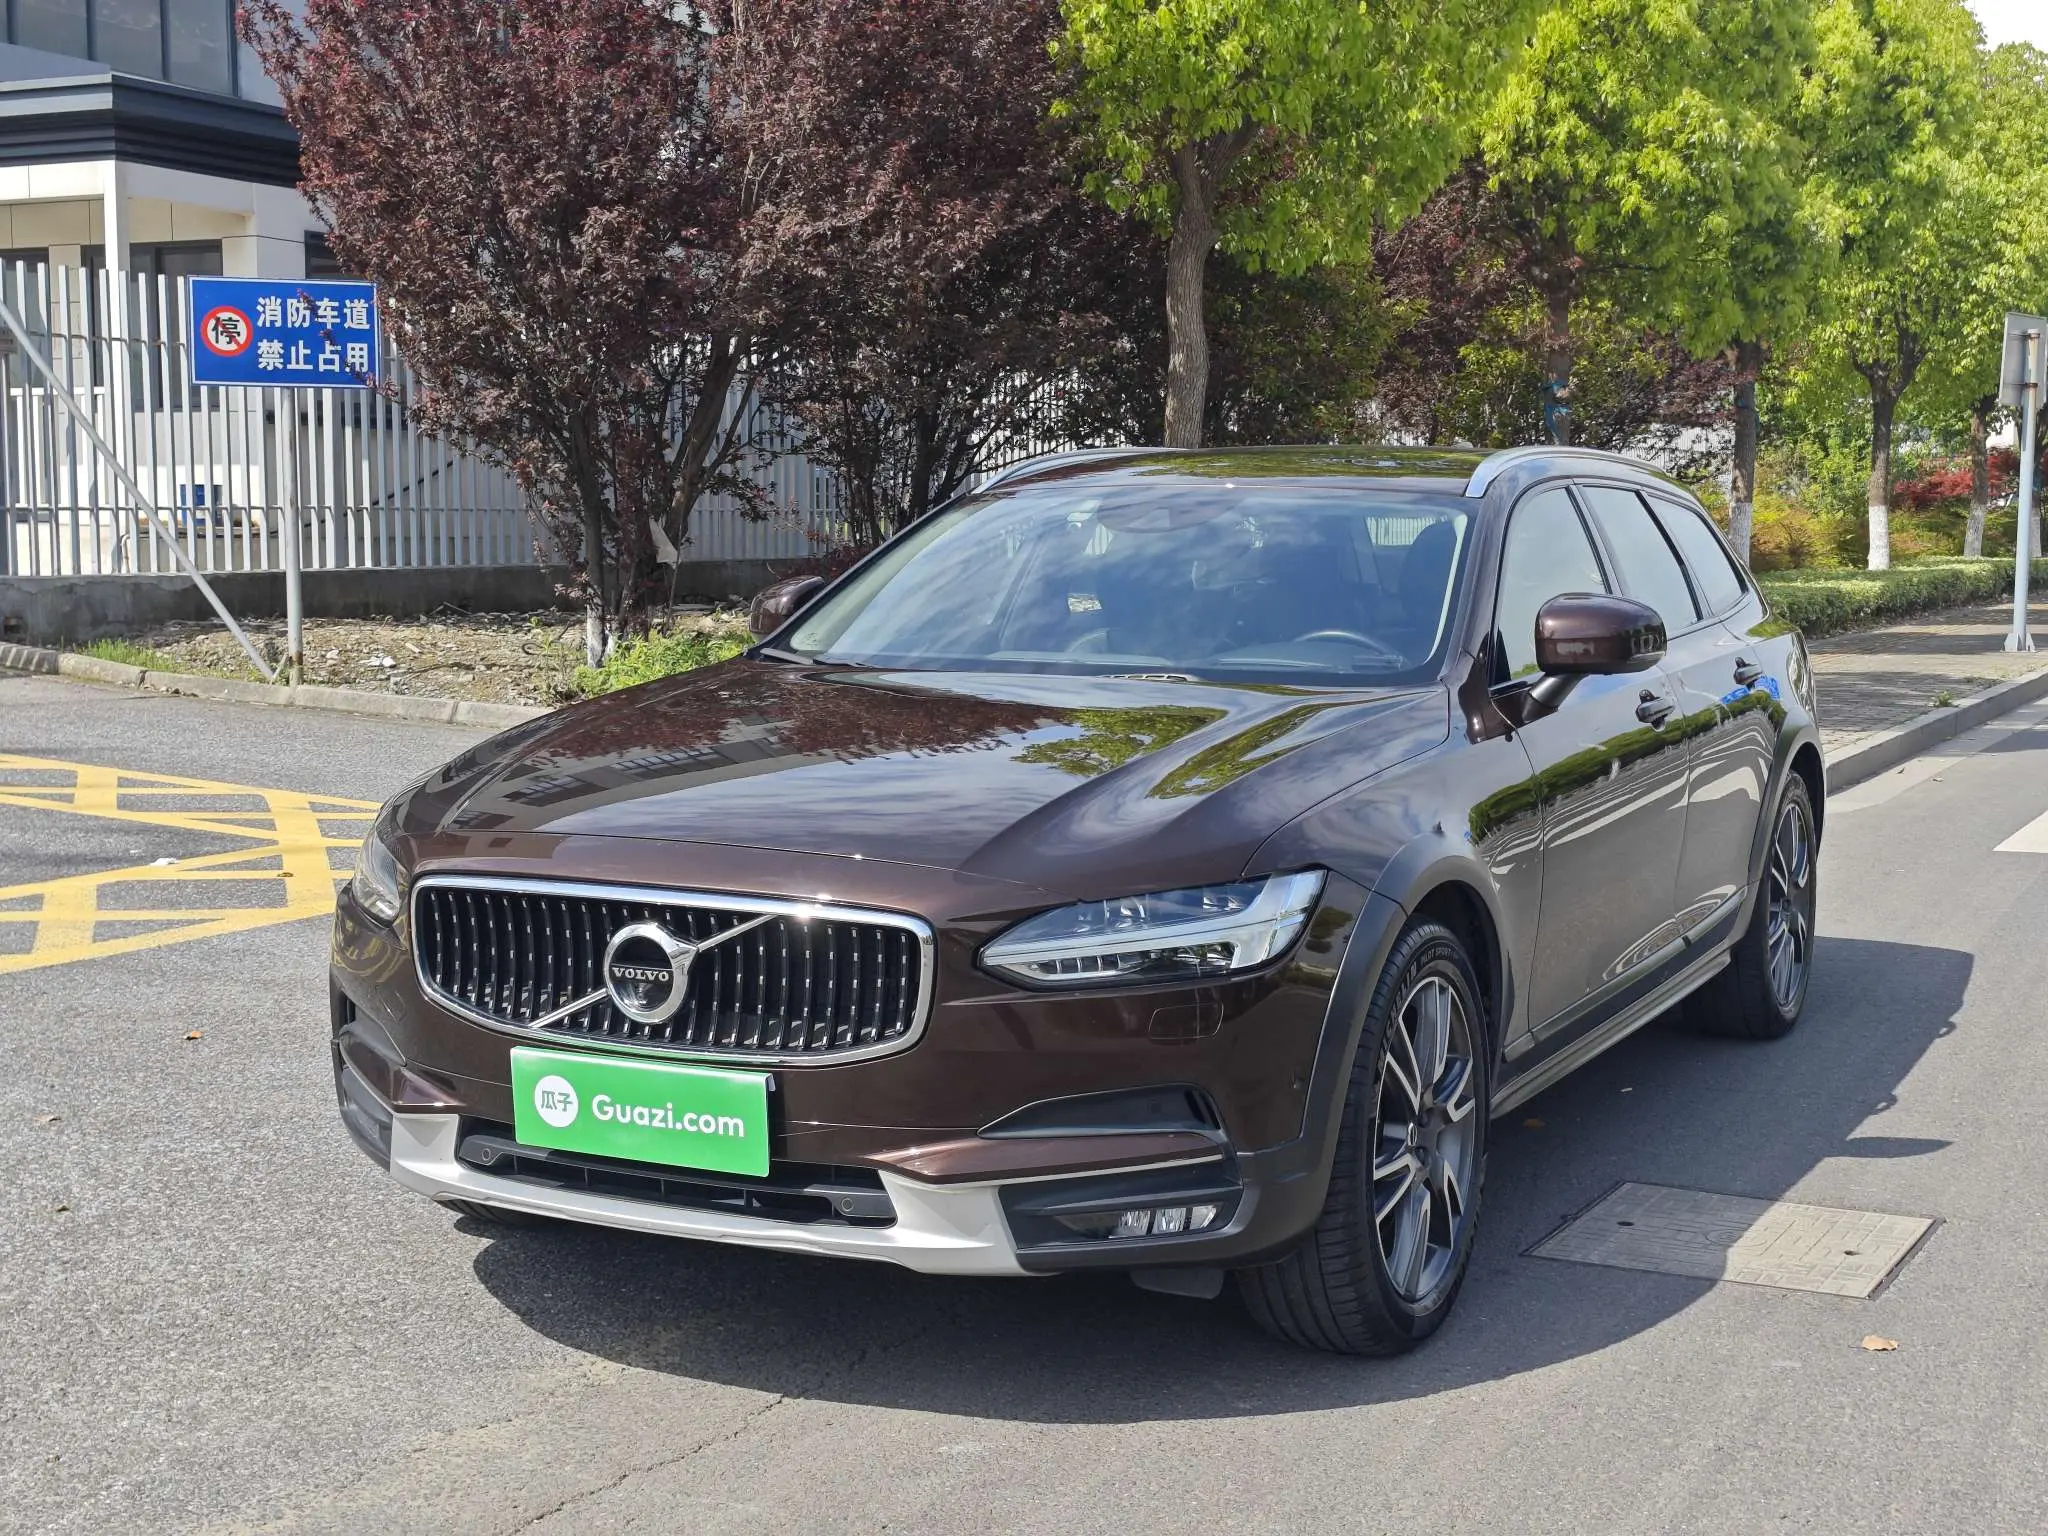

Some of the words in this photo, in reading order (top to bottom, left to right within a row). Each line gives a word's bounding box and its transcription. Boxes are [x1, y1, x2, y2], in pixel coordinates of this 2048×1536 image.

[256, 296, 370, 329] 消防车道
[211, 316, 241, 345] 停
[257, 339, 369, 372] 禁止占用
[612, 967, 669, 981] VOLVO
[541, 1090, 573, 1112] 瓜子
[592, 1094, 744, 1137] Guazi.com
